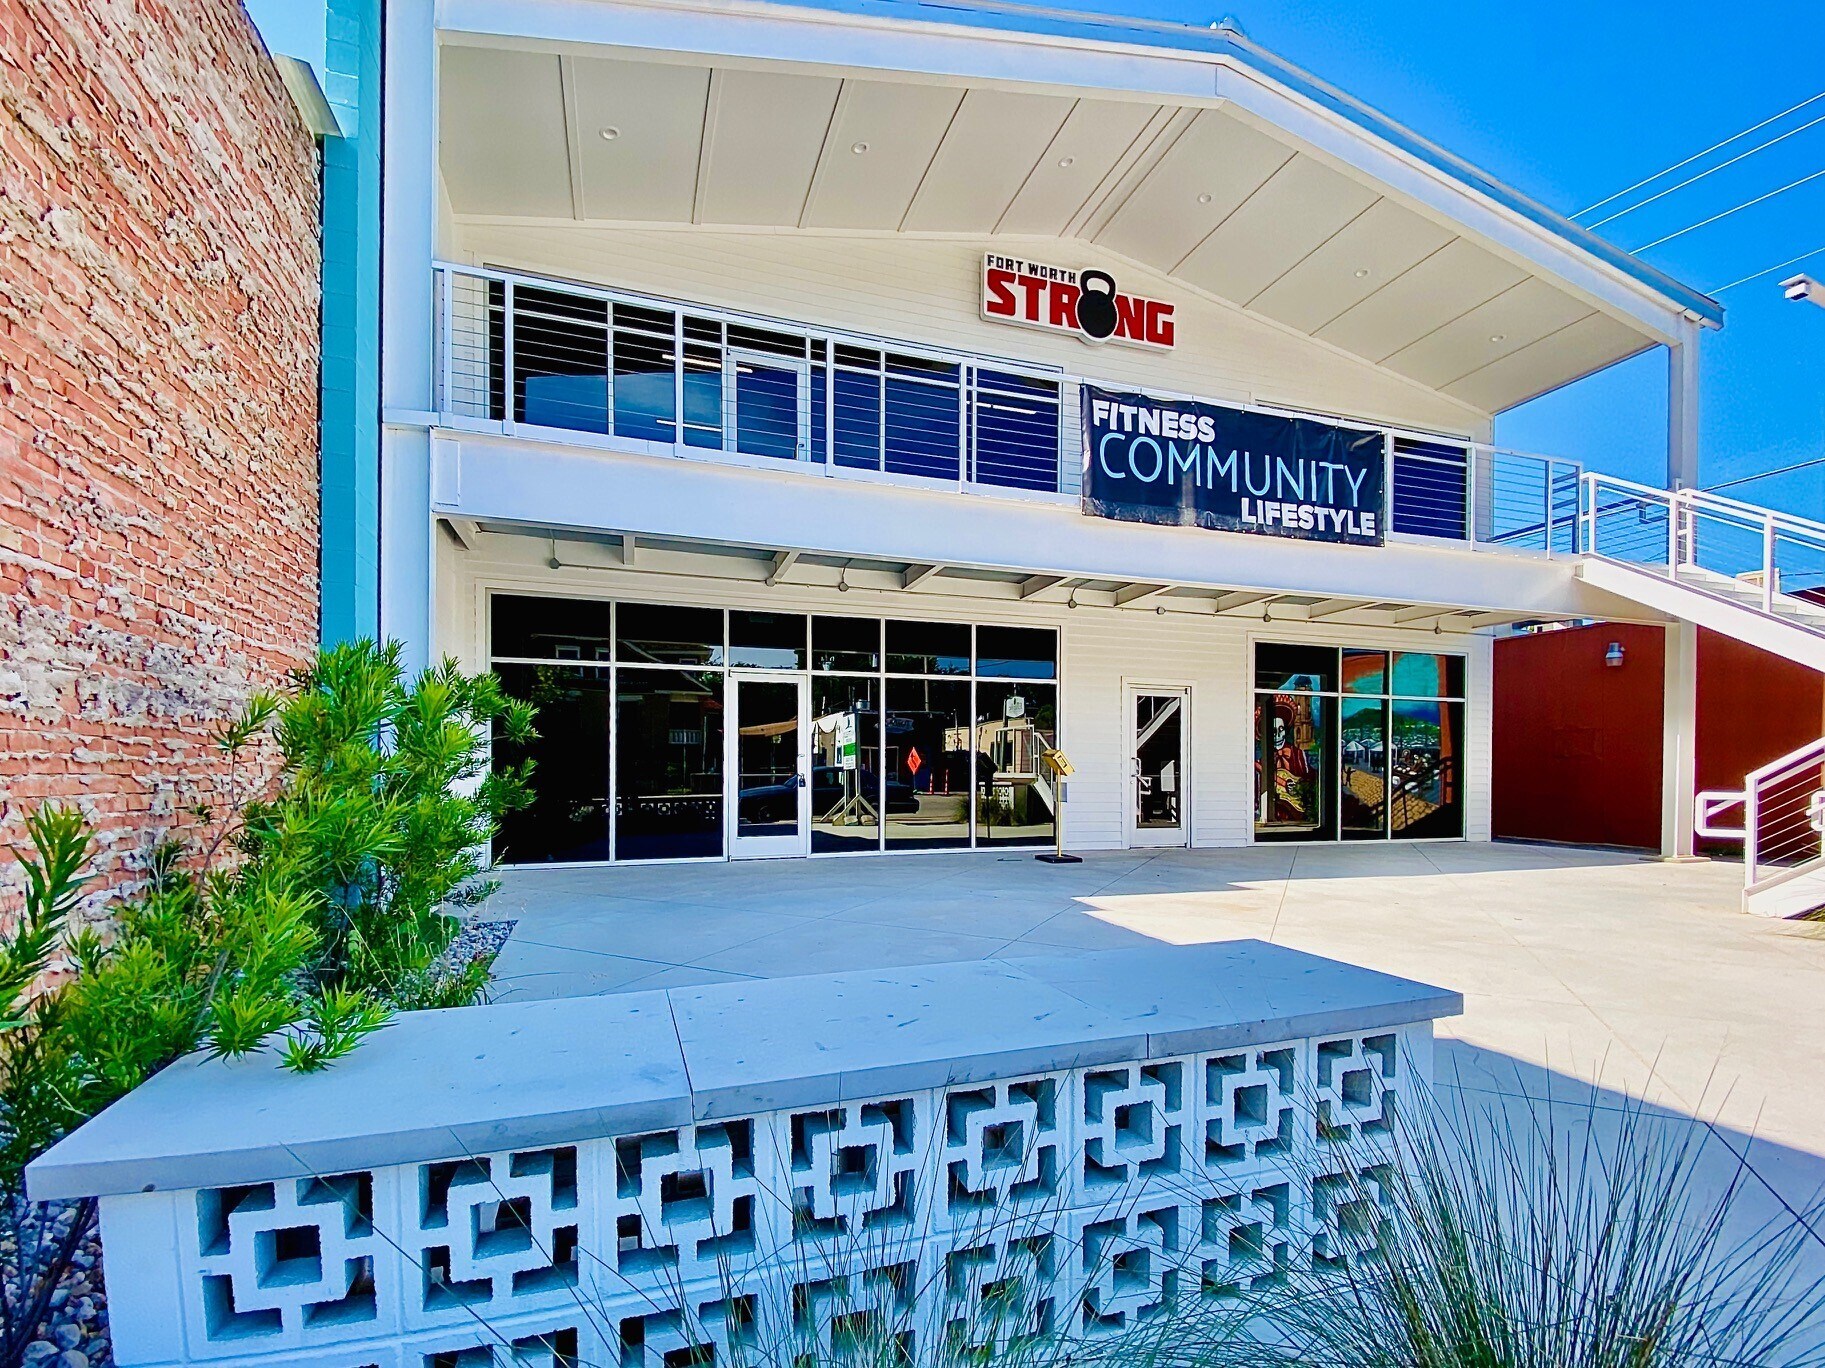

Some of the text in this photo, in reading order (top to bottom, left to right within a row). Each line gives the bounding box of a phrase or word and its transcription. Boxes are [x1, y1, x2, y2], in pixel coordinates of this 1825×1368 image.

[987, 254, 1077, 284] FORT WORTH
[1091, 398, 1216, 443] FITNESS
[1099, 432, 1368, 508] COMMUNITY
[1240, 497, 1376, 537] LIFESTYLE
